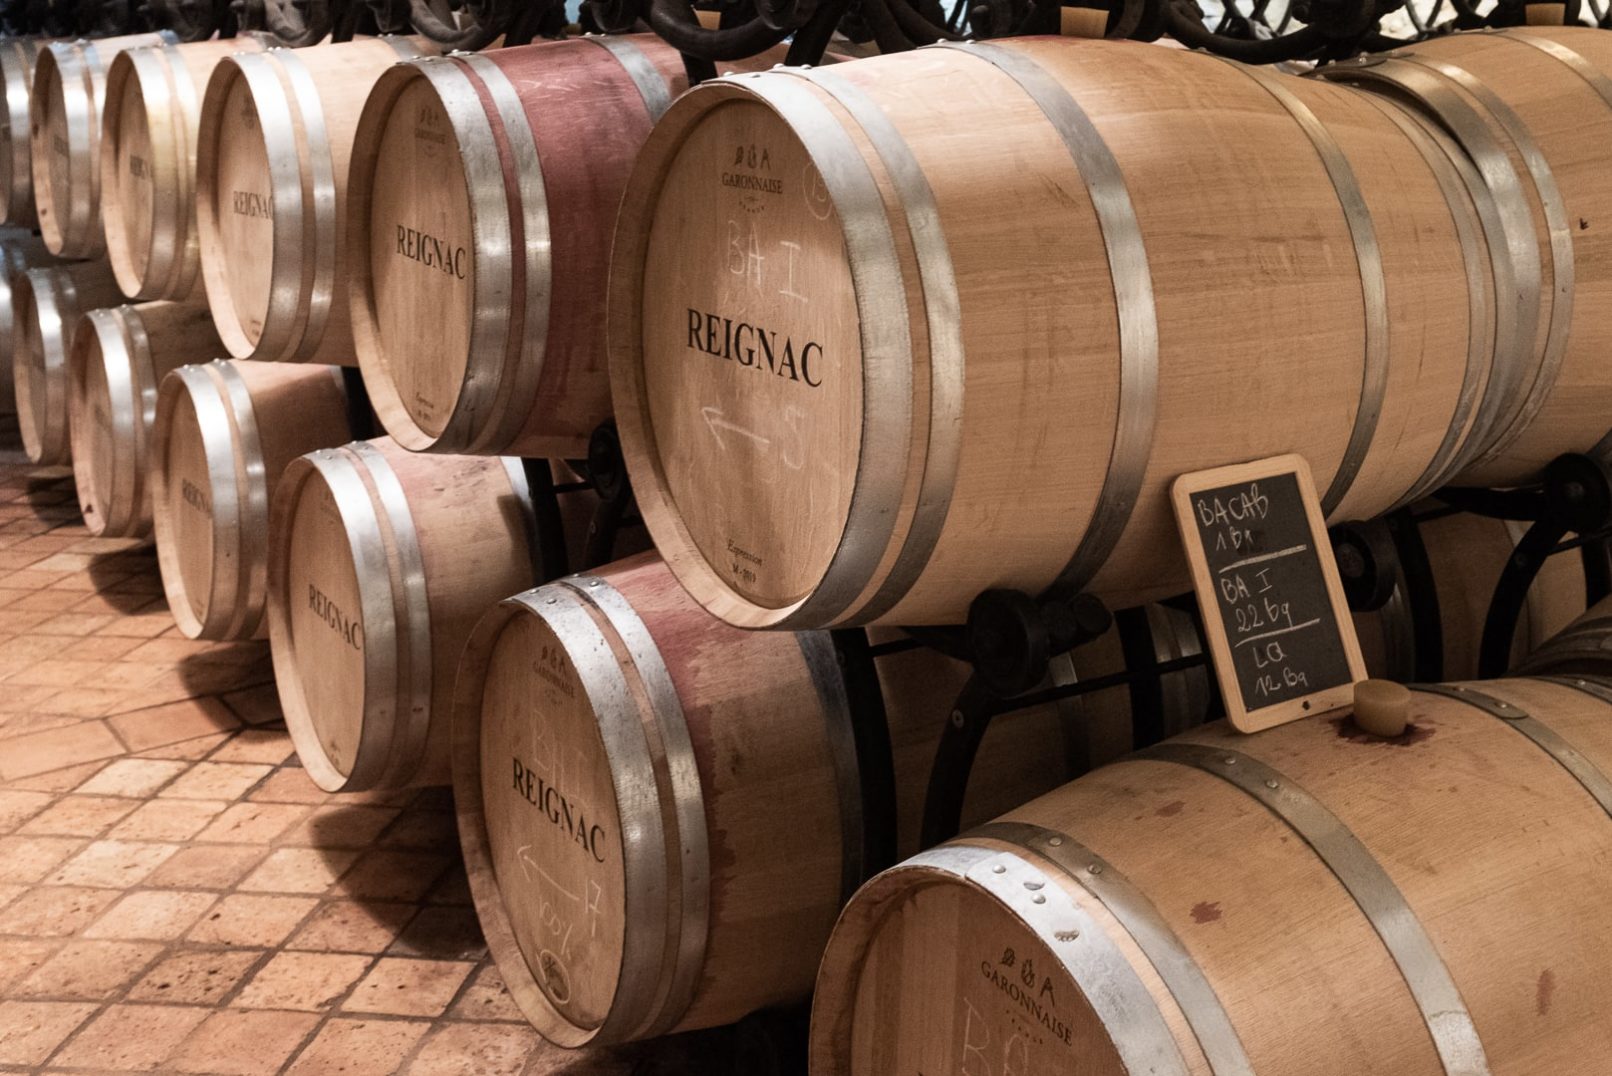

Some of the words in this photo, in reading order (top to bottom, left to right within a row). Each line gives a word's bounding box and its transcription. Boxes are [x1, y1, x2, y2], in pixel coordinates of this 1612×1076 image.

[721, 172, 783, 194] GARONNAISE
[396, 224, 466, 280] REIGNAC
[686, 308, 824, 388] REIGNAC
[1220, 572, 1250, 605] BA
[308, 584, 361, 651] REIGNAC
[1235, 604, 1264, 633] 22
[1254, 676, 1282, 697] 12
[512, 757, 606, 863] REIGNAC
[980, 961, 1073, 1048] GARONNAISE
